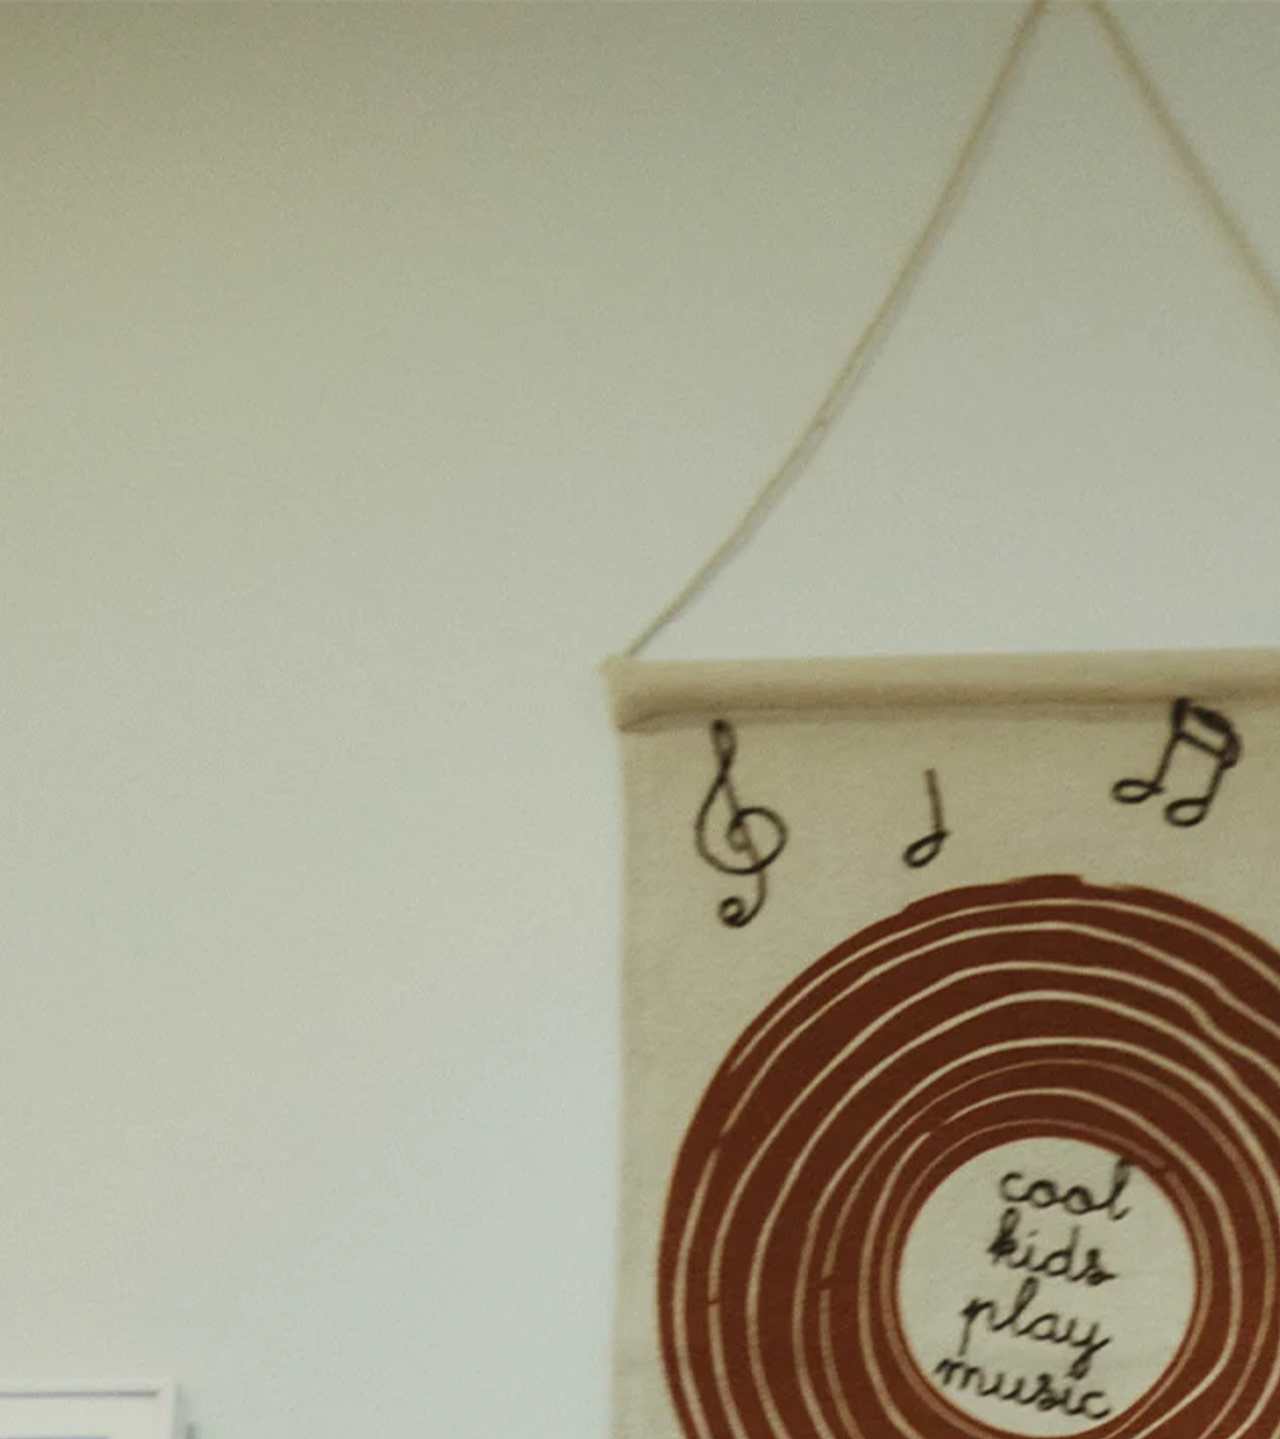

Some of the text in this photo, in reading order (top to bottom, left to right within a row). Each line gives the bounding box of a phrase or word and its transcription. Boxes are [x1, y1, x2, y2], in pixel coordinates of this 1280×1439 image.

[999, 1156, 1131, 1220] cool
[987, 1206, 1116, 1285] kids
[959, 1276, 1110, 1380] play
[934, 1358, 1110, 1419] music
